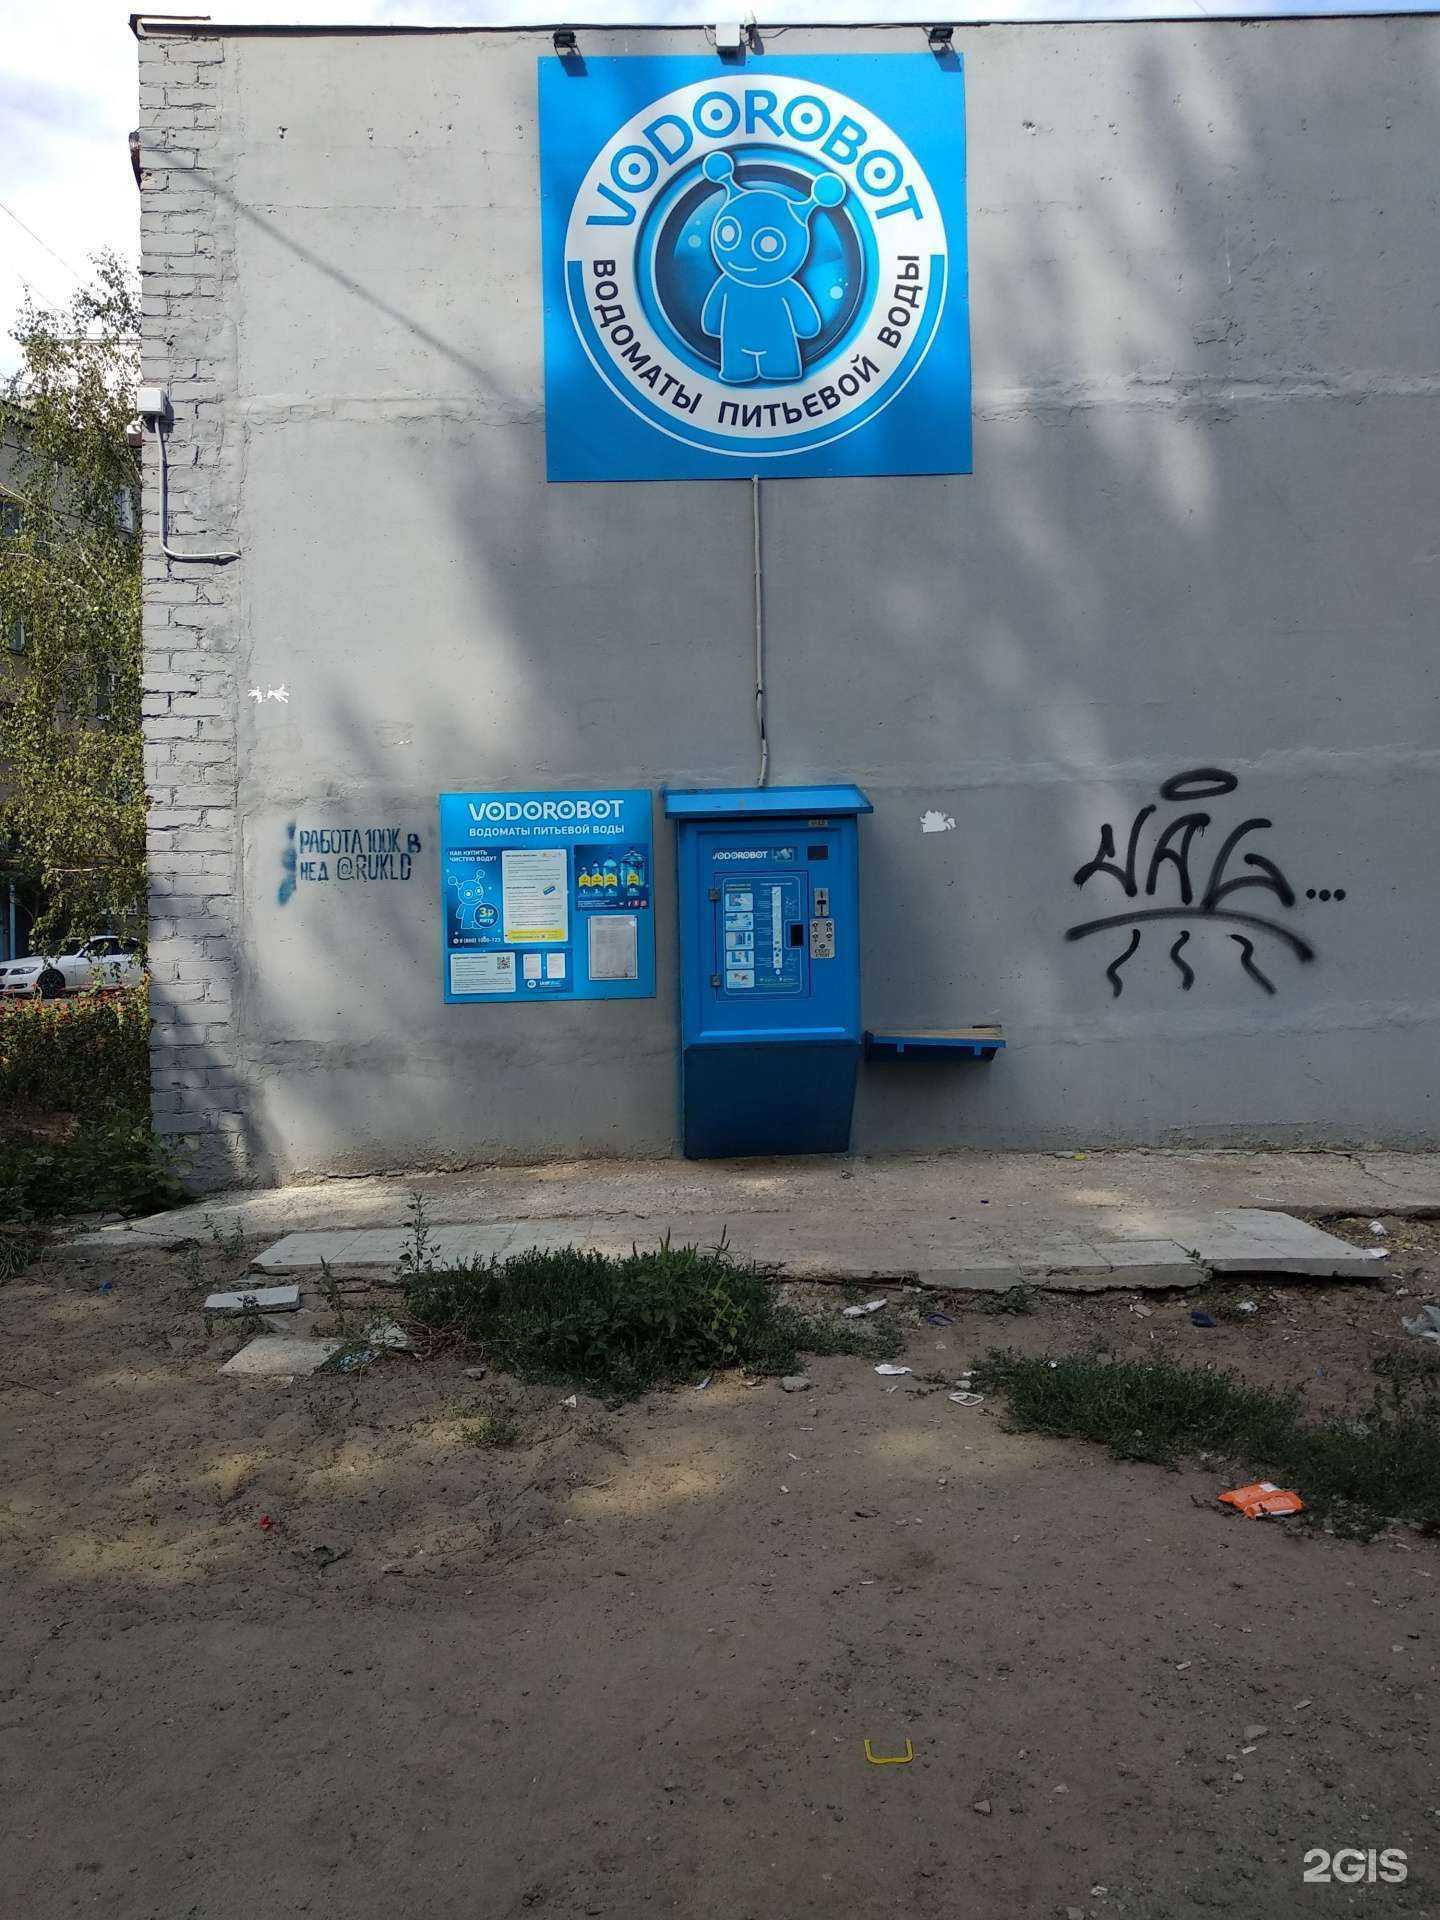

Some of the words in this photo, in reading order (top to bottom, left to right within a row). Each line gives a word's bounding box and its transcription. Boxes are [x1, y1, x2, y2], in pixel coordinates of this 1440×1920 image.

[585, 89, 923, 228] VODOROBOT
[592, 259, 703, 414] ВОДОМАТЫ
[717, 354, 881, 428] ПИТЬЕВОЙ
[876, 255, 923, 350] ВОДЫ
[468, 799, 624, 822] VODOROBOT
[300, 829, 363, 854] РАБОТА
[469, 827, 530, 838] ВОДОМАТЫ
[533, 823, 590, 836] ПИТЬЕВОЙ
[592, 825, 625, 836] ВОДЫ
